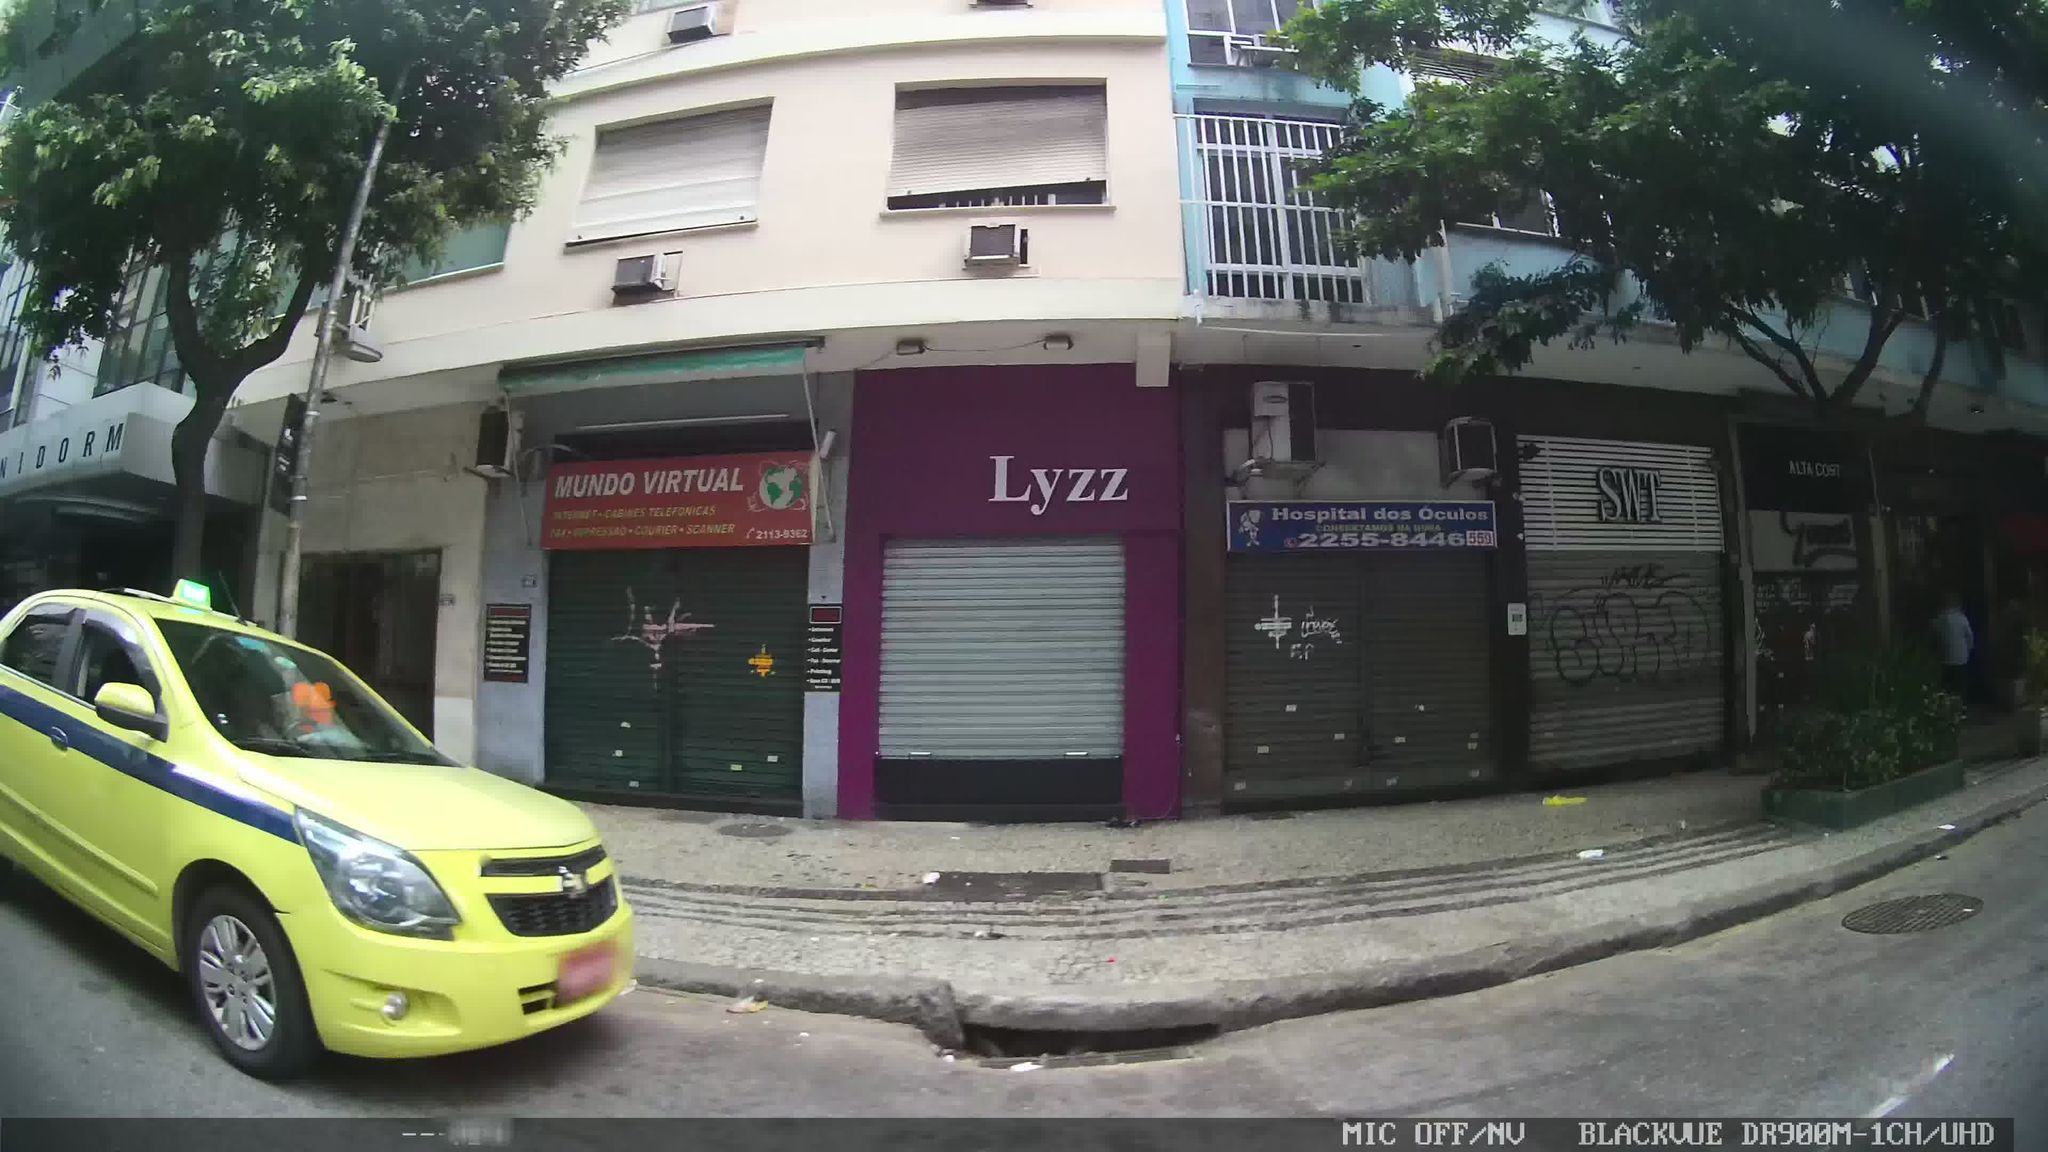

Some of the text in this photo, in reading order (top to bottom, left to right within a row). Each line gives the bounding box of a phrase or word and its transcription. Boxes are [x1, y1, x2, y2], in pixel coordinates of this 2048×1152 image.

[554, 467, 744, 499] MUNDO VIRTUAL
[988, 455, 1129, 516] Lyzz
[1599, 468, 1661, 521] SWT
[1272, 504, 1488, 524] Hospital dos Óculos
[633, 524, 677, 536] COURIER
[686, 523, 736, 535] SCANNER
[1298, 532, 1465, 548] 2255-8446
